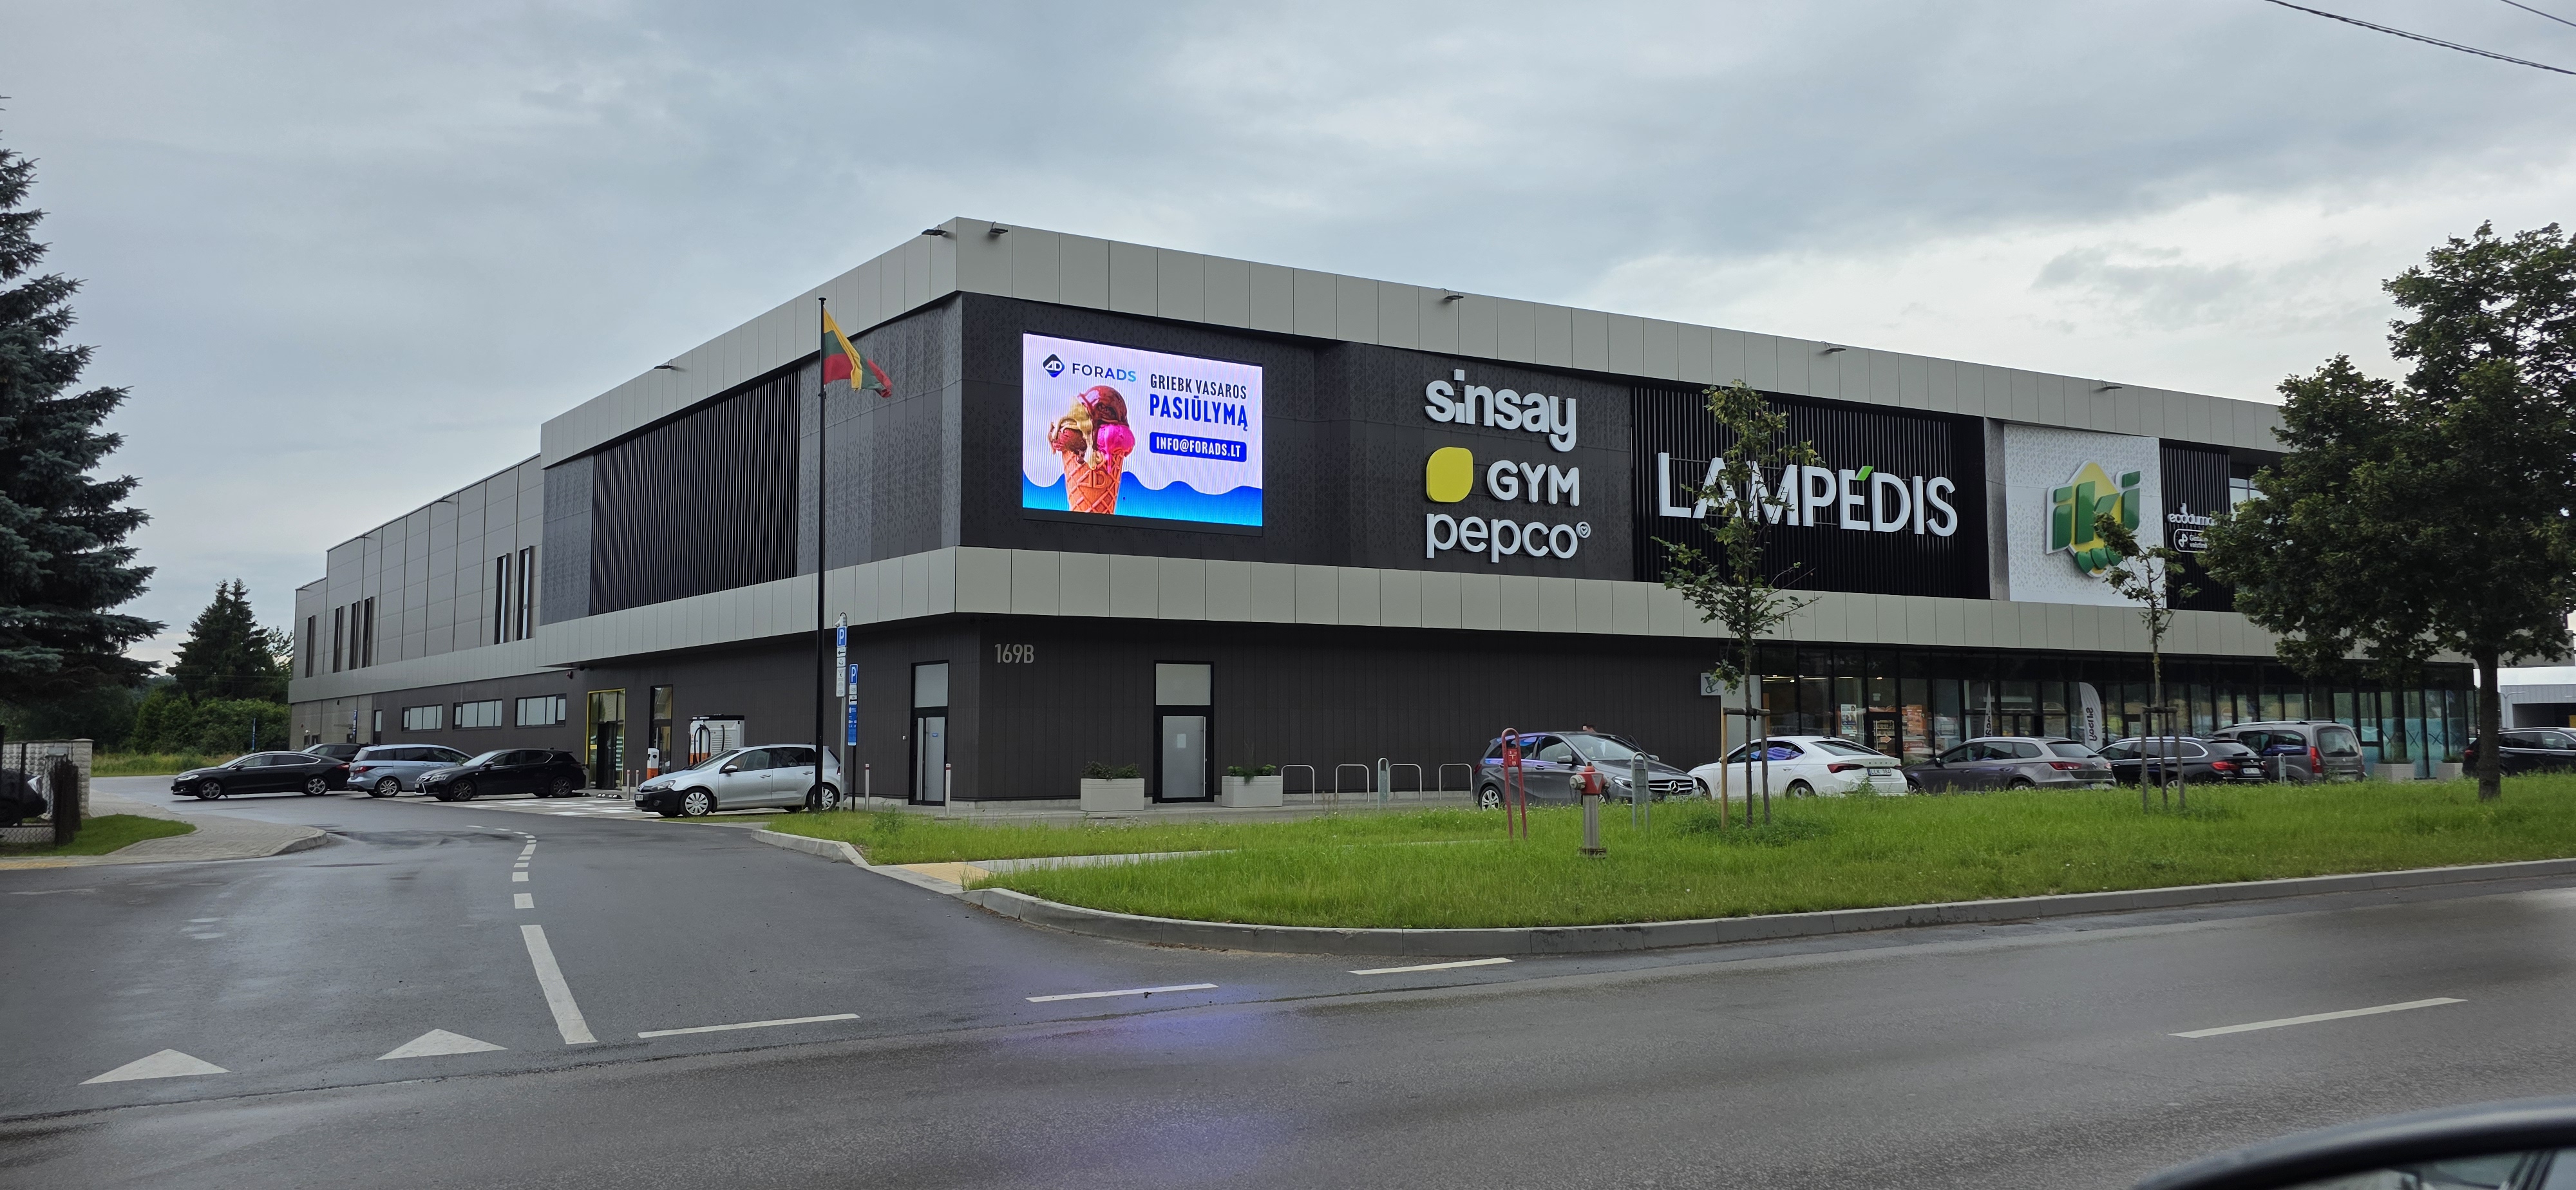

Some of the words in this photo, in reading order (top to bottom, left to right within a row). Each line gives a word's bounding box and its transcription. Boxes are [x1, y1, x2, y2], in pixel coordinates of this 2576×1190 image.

[1072, 363, 1137, 382] FORADS
[1150, 373, 1192, 393] GRIEBK
[1195, 379, 1247, 399] VASAROS
[1150, 393, 1248, 431] PASIŪLYMĄ
[1425, 368, 1577, 452] sinsay
[1156, 436, 1241, 458] INFO@FORADS.LT
[1486, 460, 1580, 507] GYM
[838, 628, 845, 645] P
[994, 643, 1034, 664] 169B
[851, 666, 857, 683] P
